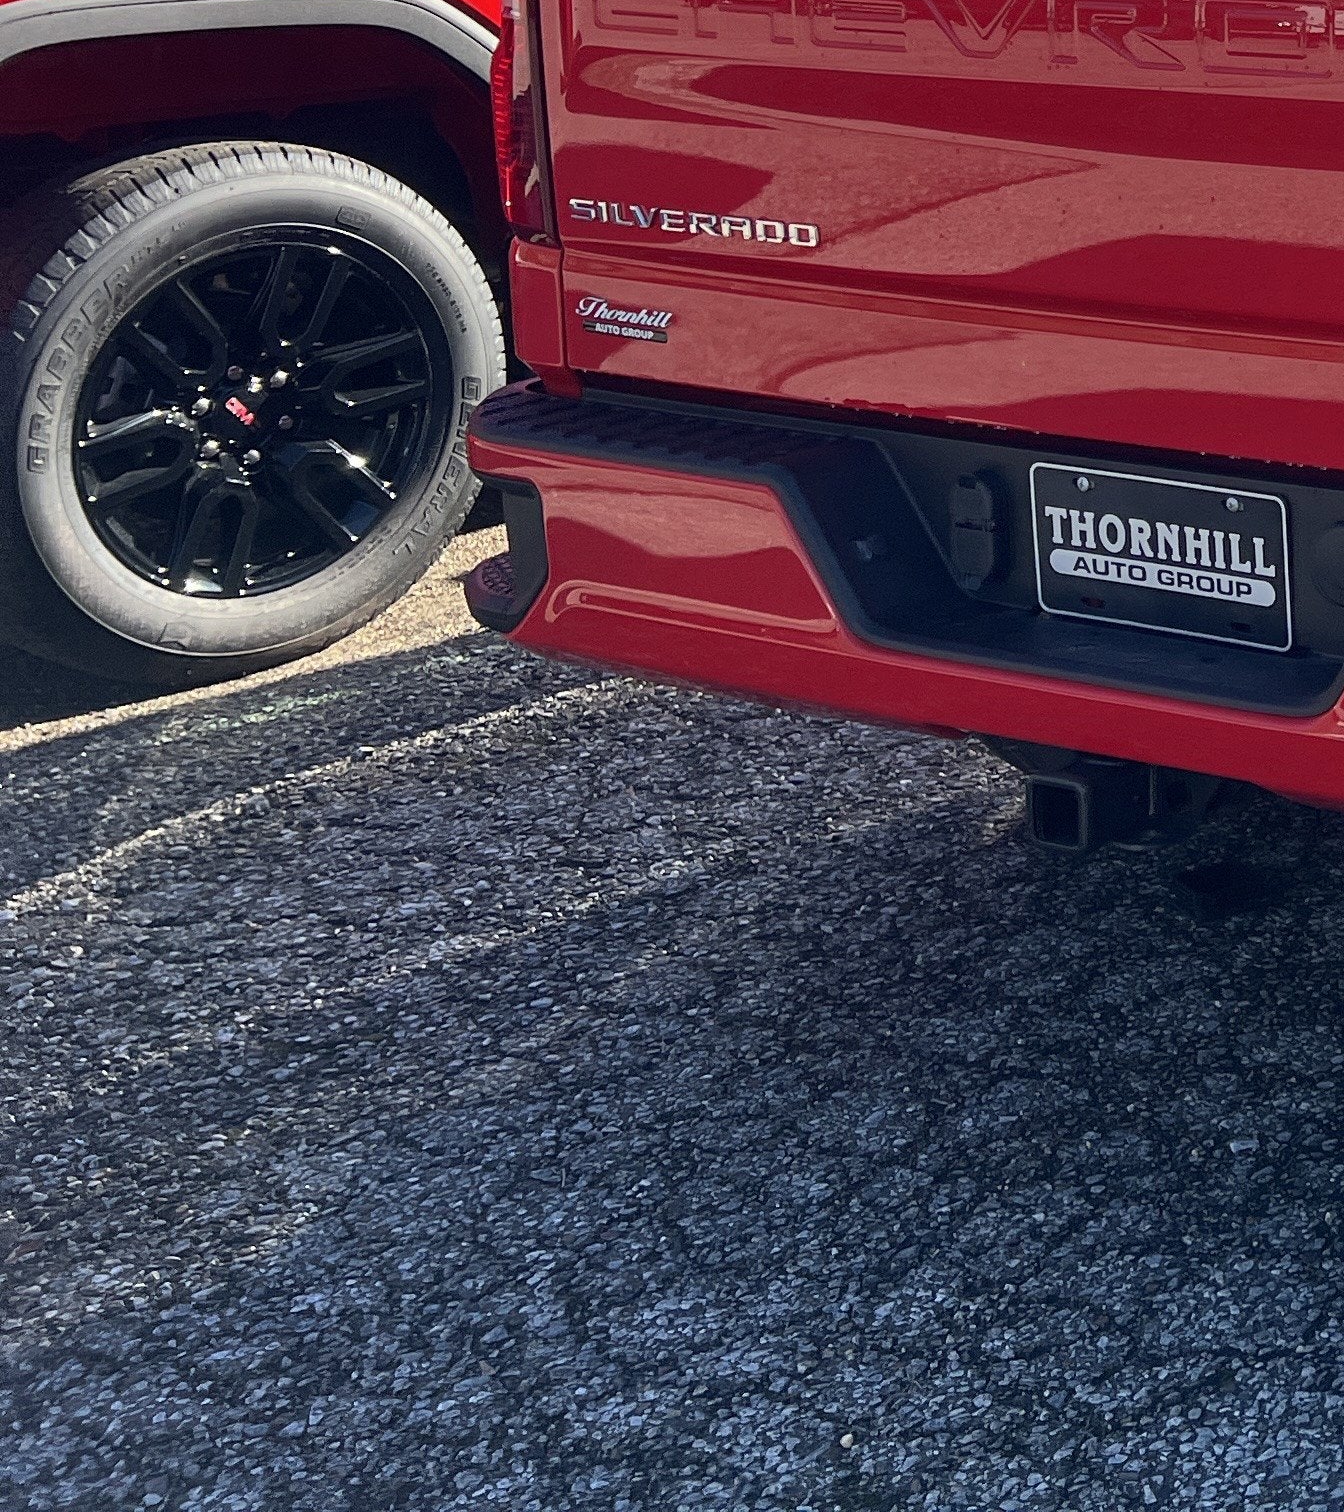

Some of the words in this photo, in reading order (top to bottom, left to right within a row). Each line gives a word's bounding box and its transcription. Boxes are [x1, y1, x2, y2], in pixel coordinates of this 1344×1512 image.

[568, 198, 820, 248] SILVERADO
[575, 295, 673, 329] Thornhill
[594, 322, 620, 337] AUTO
[621, 326, 655, 340] GROUP
[1044, 505, 1276, 578] THORNHILL
[1072, 556, 1147, 582] AUTO
[1156, 569, 1253, 598] GROUP
